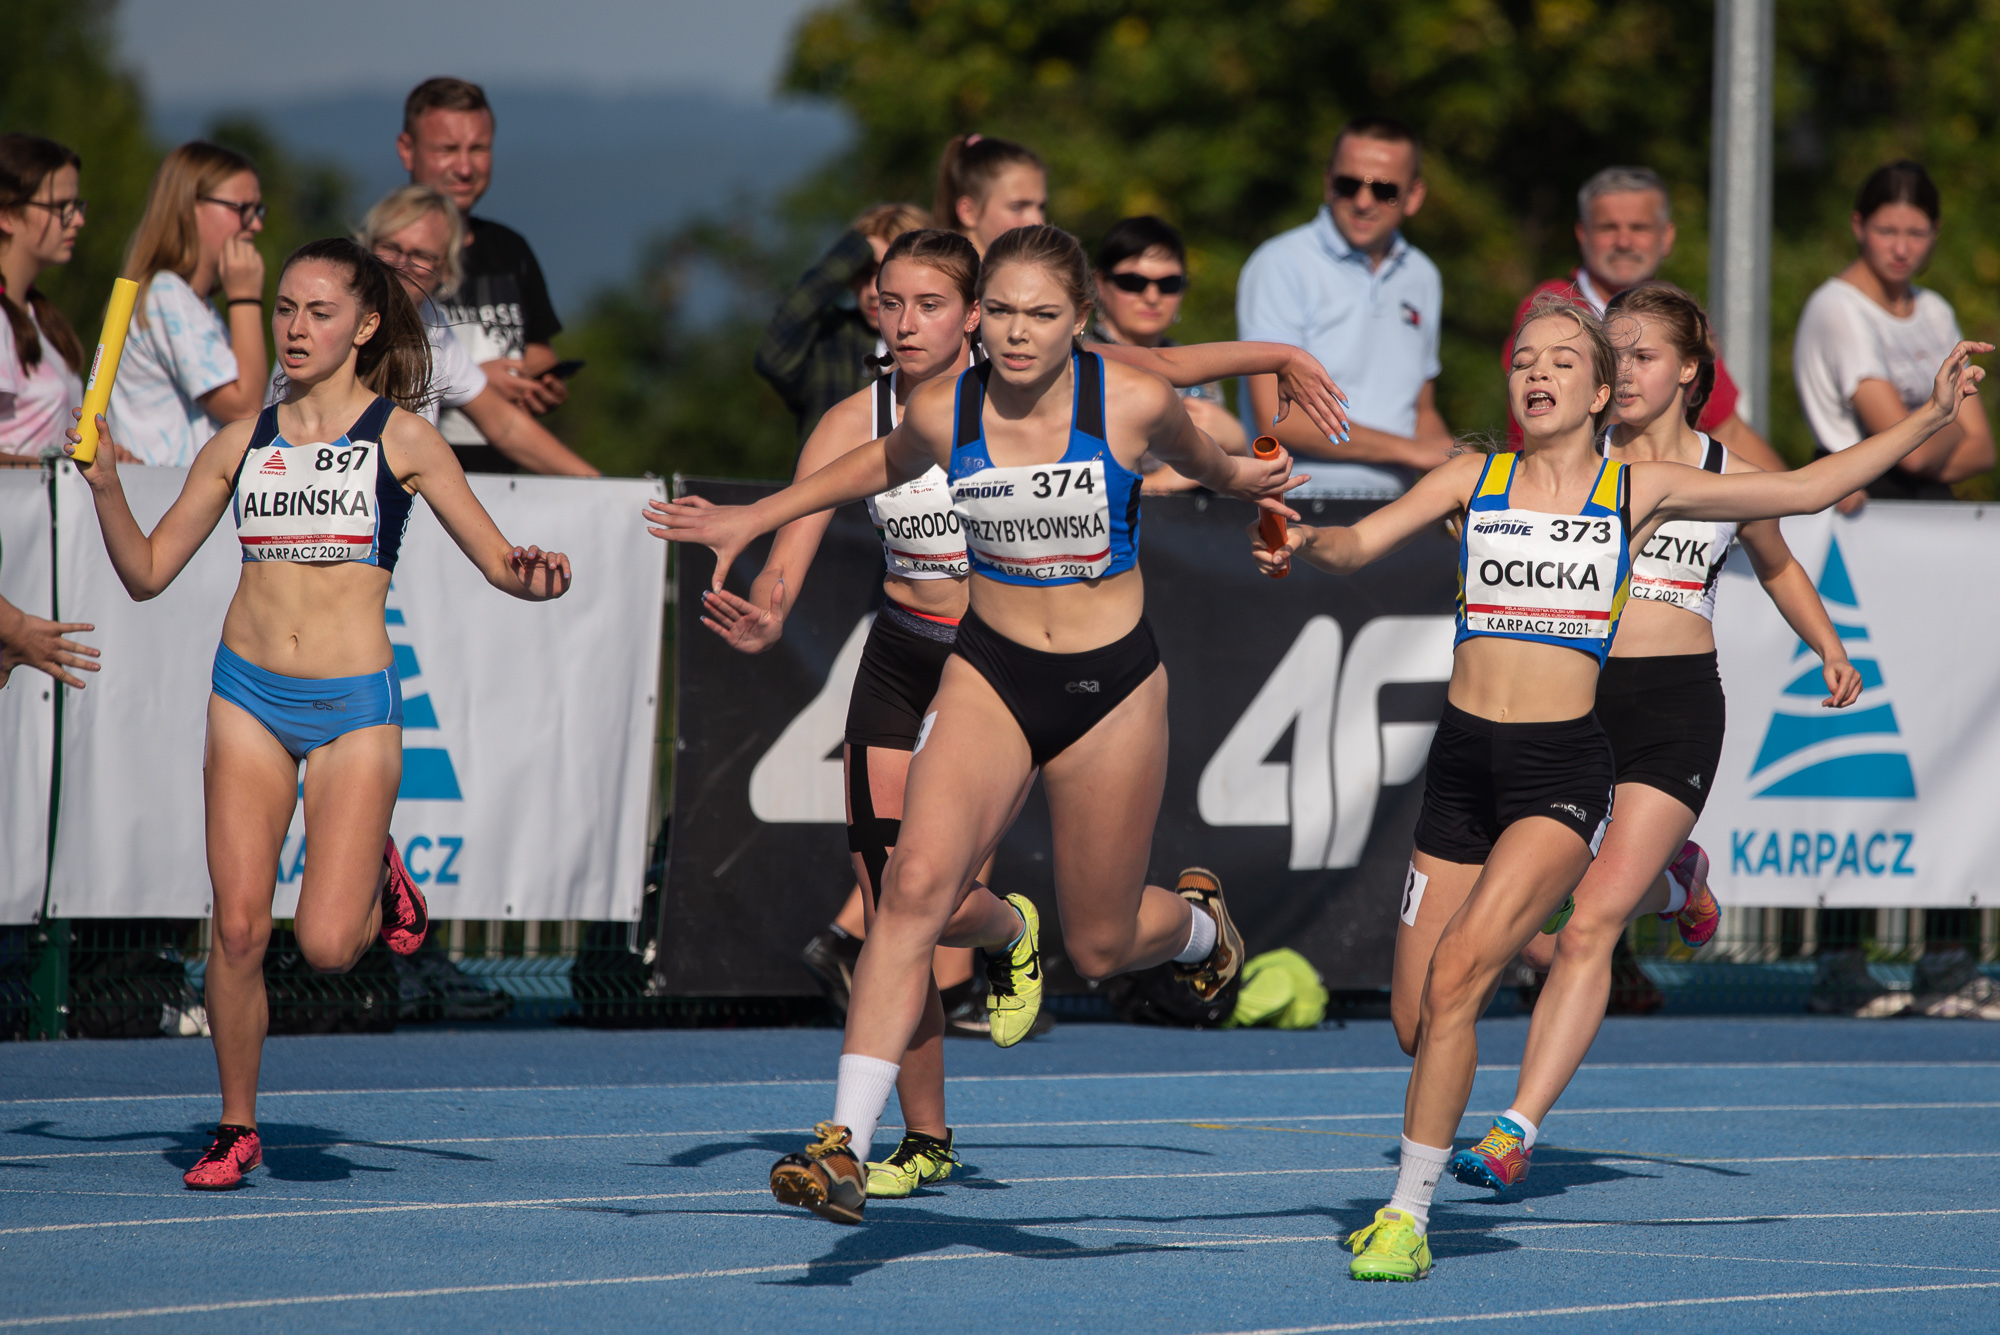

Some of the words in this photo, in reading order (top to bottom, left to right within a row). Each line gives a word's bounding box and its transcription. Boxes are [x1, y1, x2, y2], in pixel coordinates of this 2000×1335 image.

[315, 447, 370, 473] 897
[1031, 468, 1094, 498] 374
[244, 485, 370, 519] ALBIŃSKA
[886, 510, 960, 539] OGRODO
[960, 513, 1105, 543] PRZYBYŁOWSKA
[1473, 523, 1534, 536] 4MOVE
[1549, 519, 1611, 544] 373
[258, 547, 317, 560] KARPACZ
[320, 546, 350, 559] 2021
[1060, 565, 1094, 576] 2021
[1479, 559, 1600, 592] OCICKA
[1654, 589, 1684, 604] 2021
[1487, 617, 1554, 634] KARPACZ
[1559, 622, 1589, 636] 2021
[1198, 614, 1456, 871] 4F
[1731, 830, 1916, 877] KARPACZ
